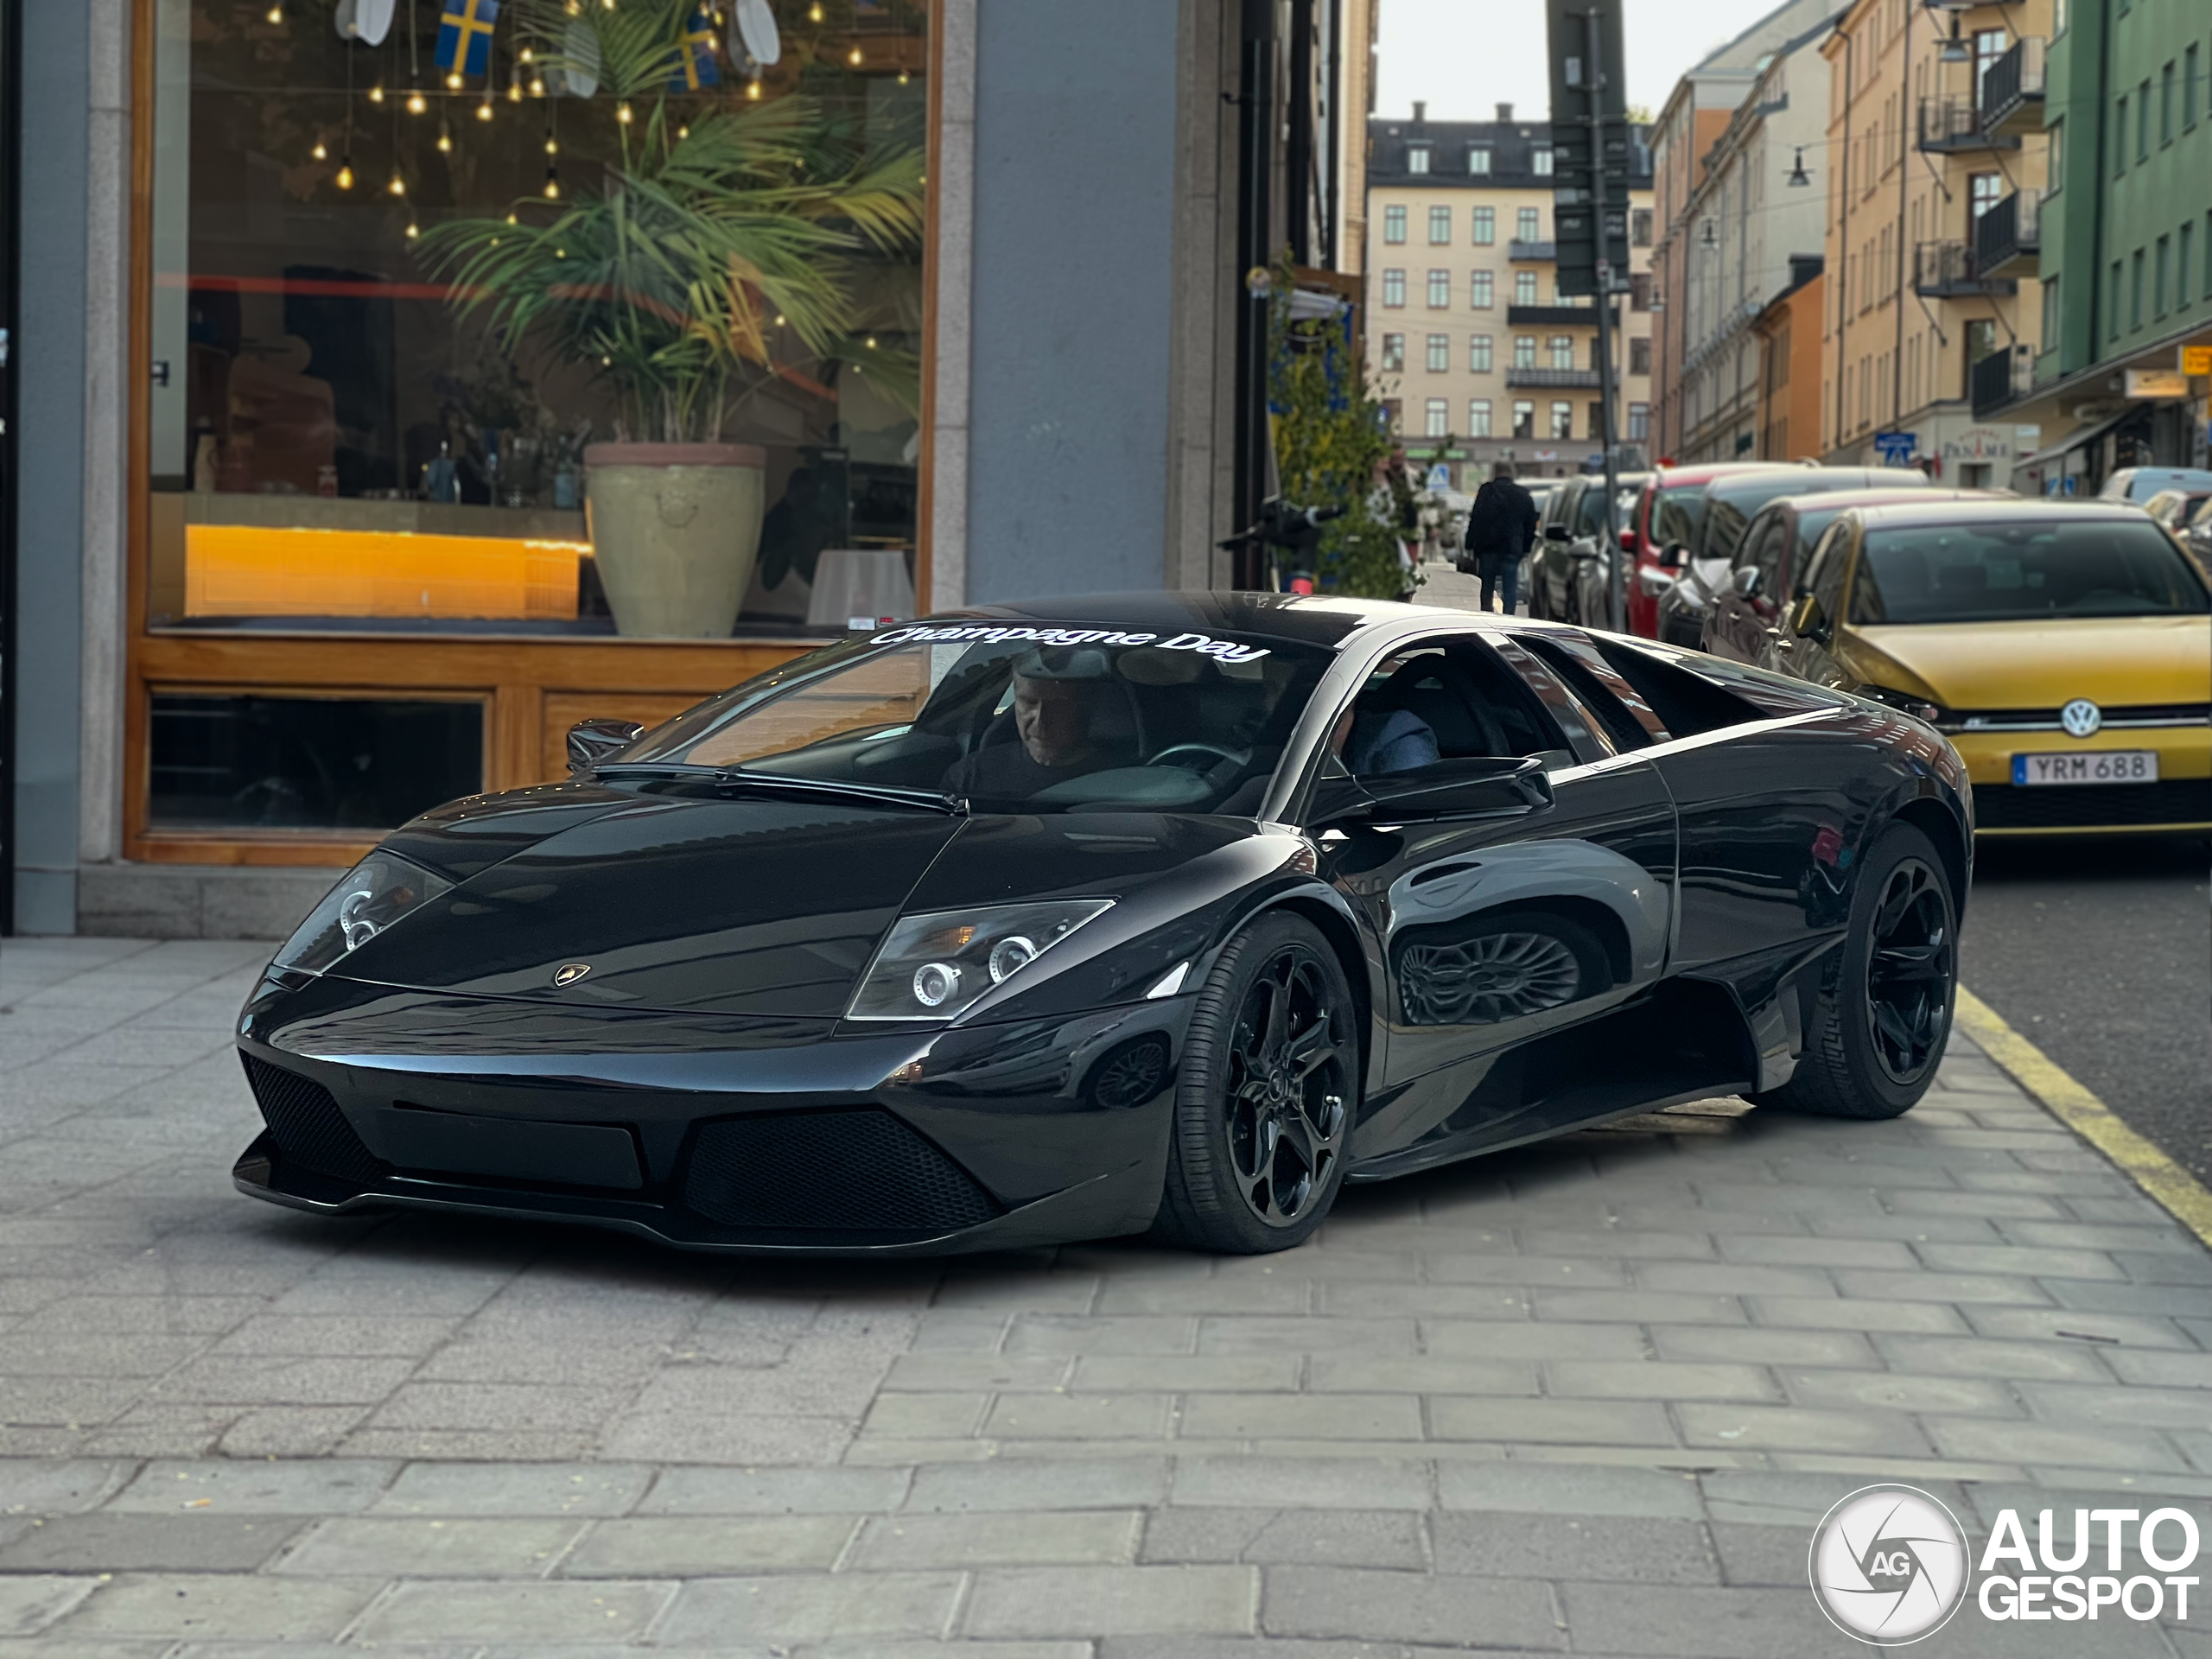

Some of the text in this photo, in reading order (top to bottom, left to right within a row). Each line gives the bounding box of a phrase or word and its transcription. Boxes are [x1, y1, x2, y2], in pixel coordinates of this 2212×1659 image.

[869, 626, 1272, 664] Champagne Day
[2036, 755, 2147, 780] YRM 688
